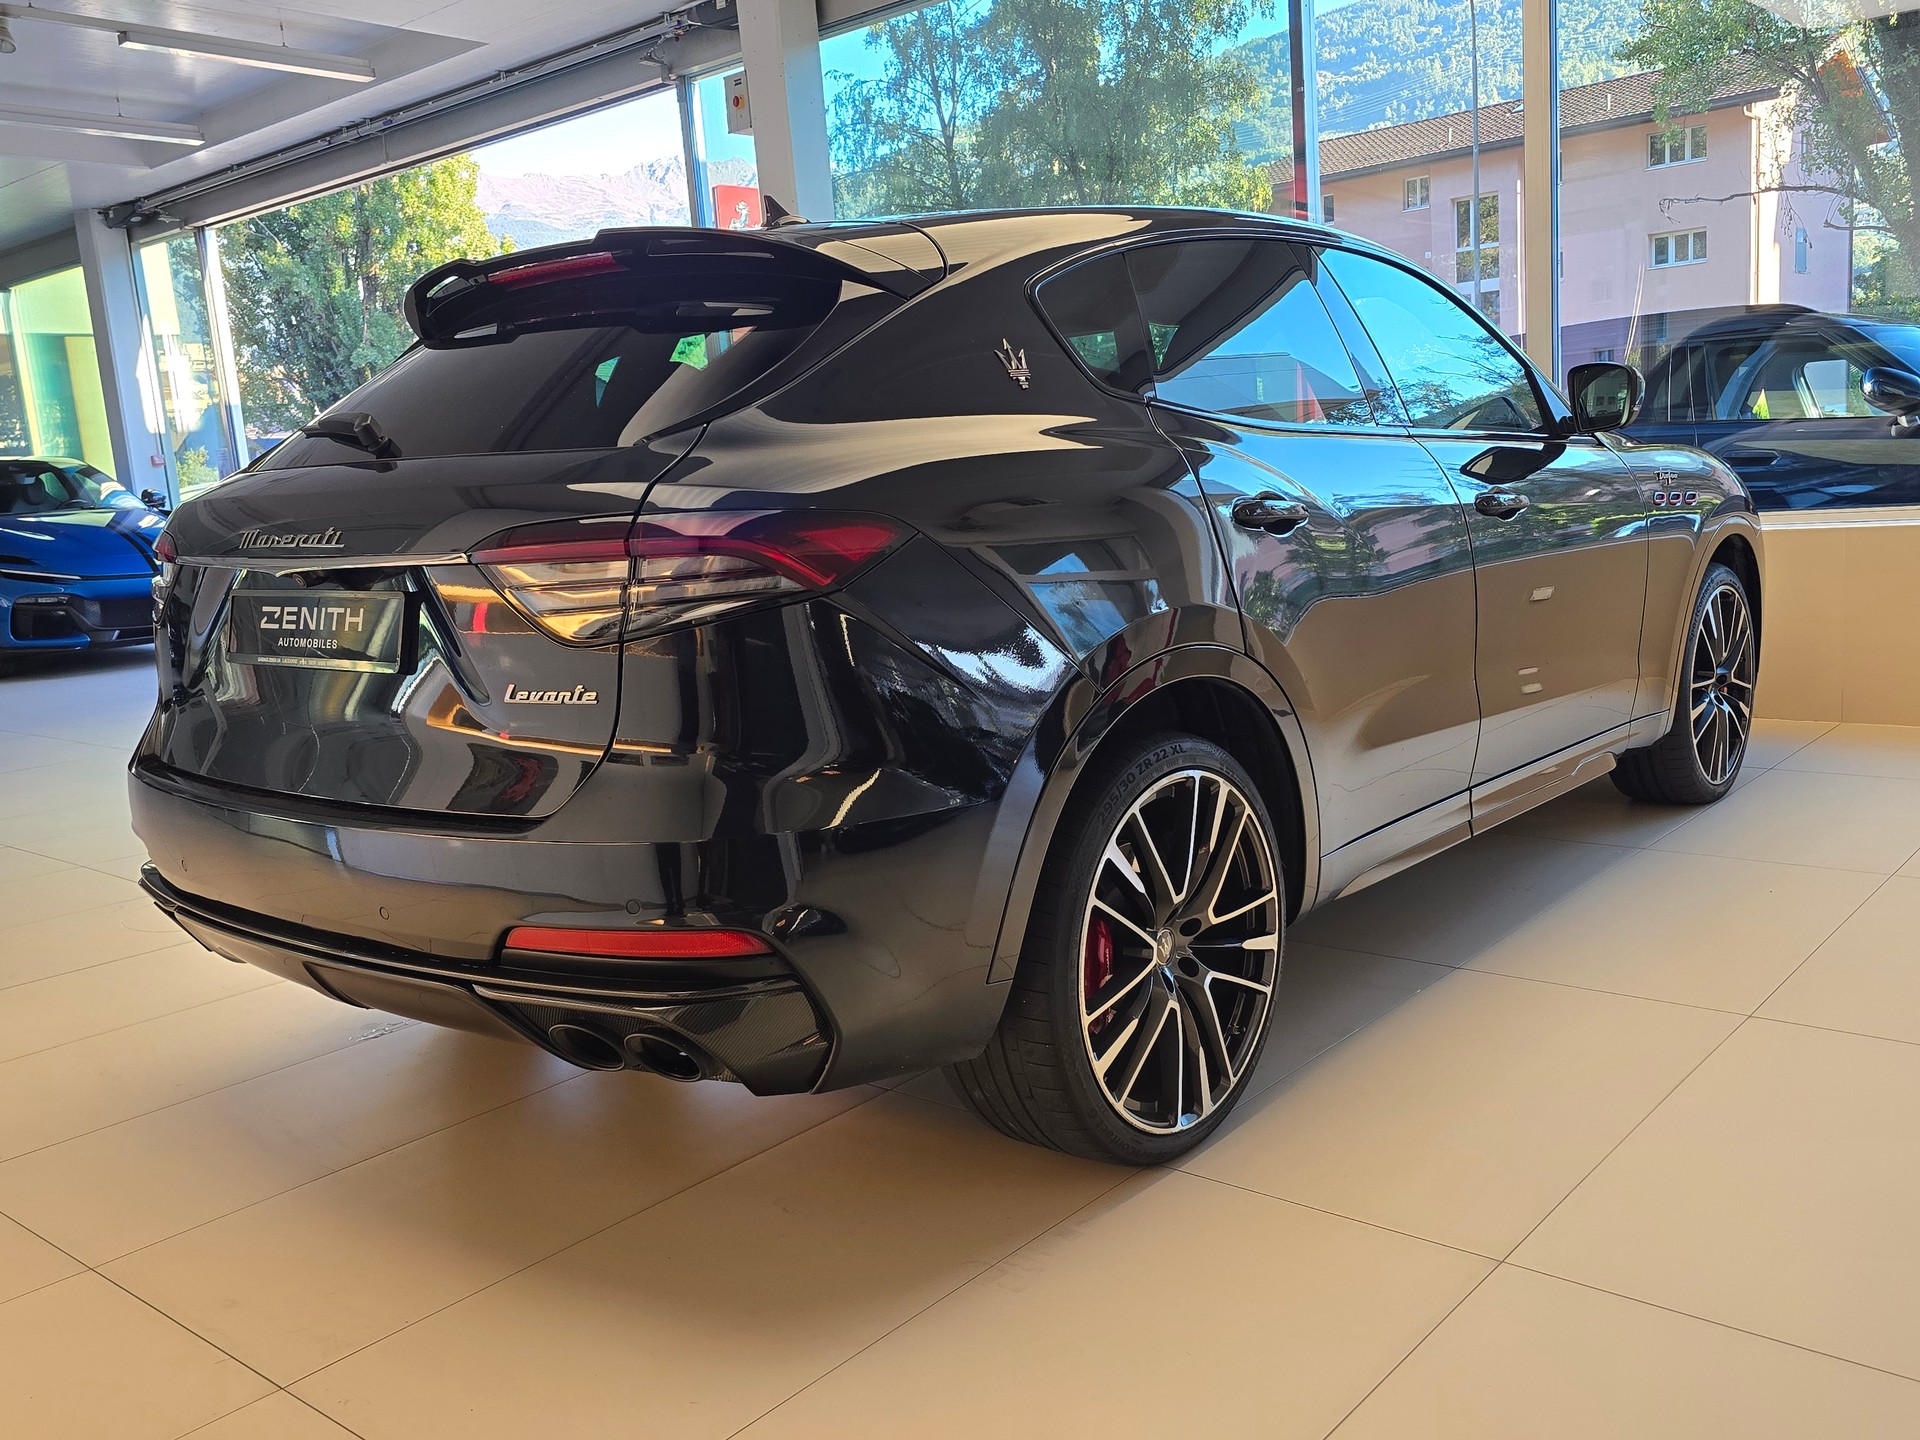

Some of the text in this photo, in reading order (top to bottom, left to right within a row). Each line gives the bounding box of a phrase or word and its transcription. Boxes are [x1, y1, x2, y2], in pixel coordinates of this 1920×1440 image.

[238, 526, 346, 549] Maserati
[260, 605, 365, 632] ZENITH
[277, 637, 338, 649] AUTOMOBILES
[504, 684, 599, 705] Levante
[1096, 743, 1187, 825] 295/30 ZR 22 XL
